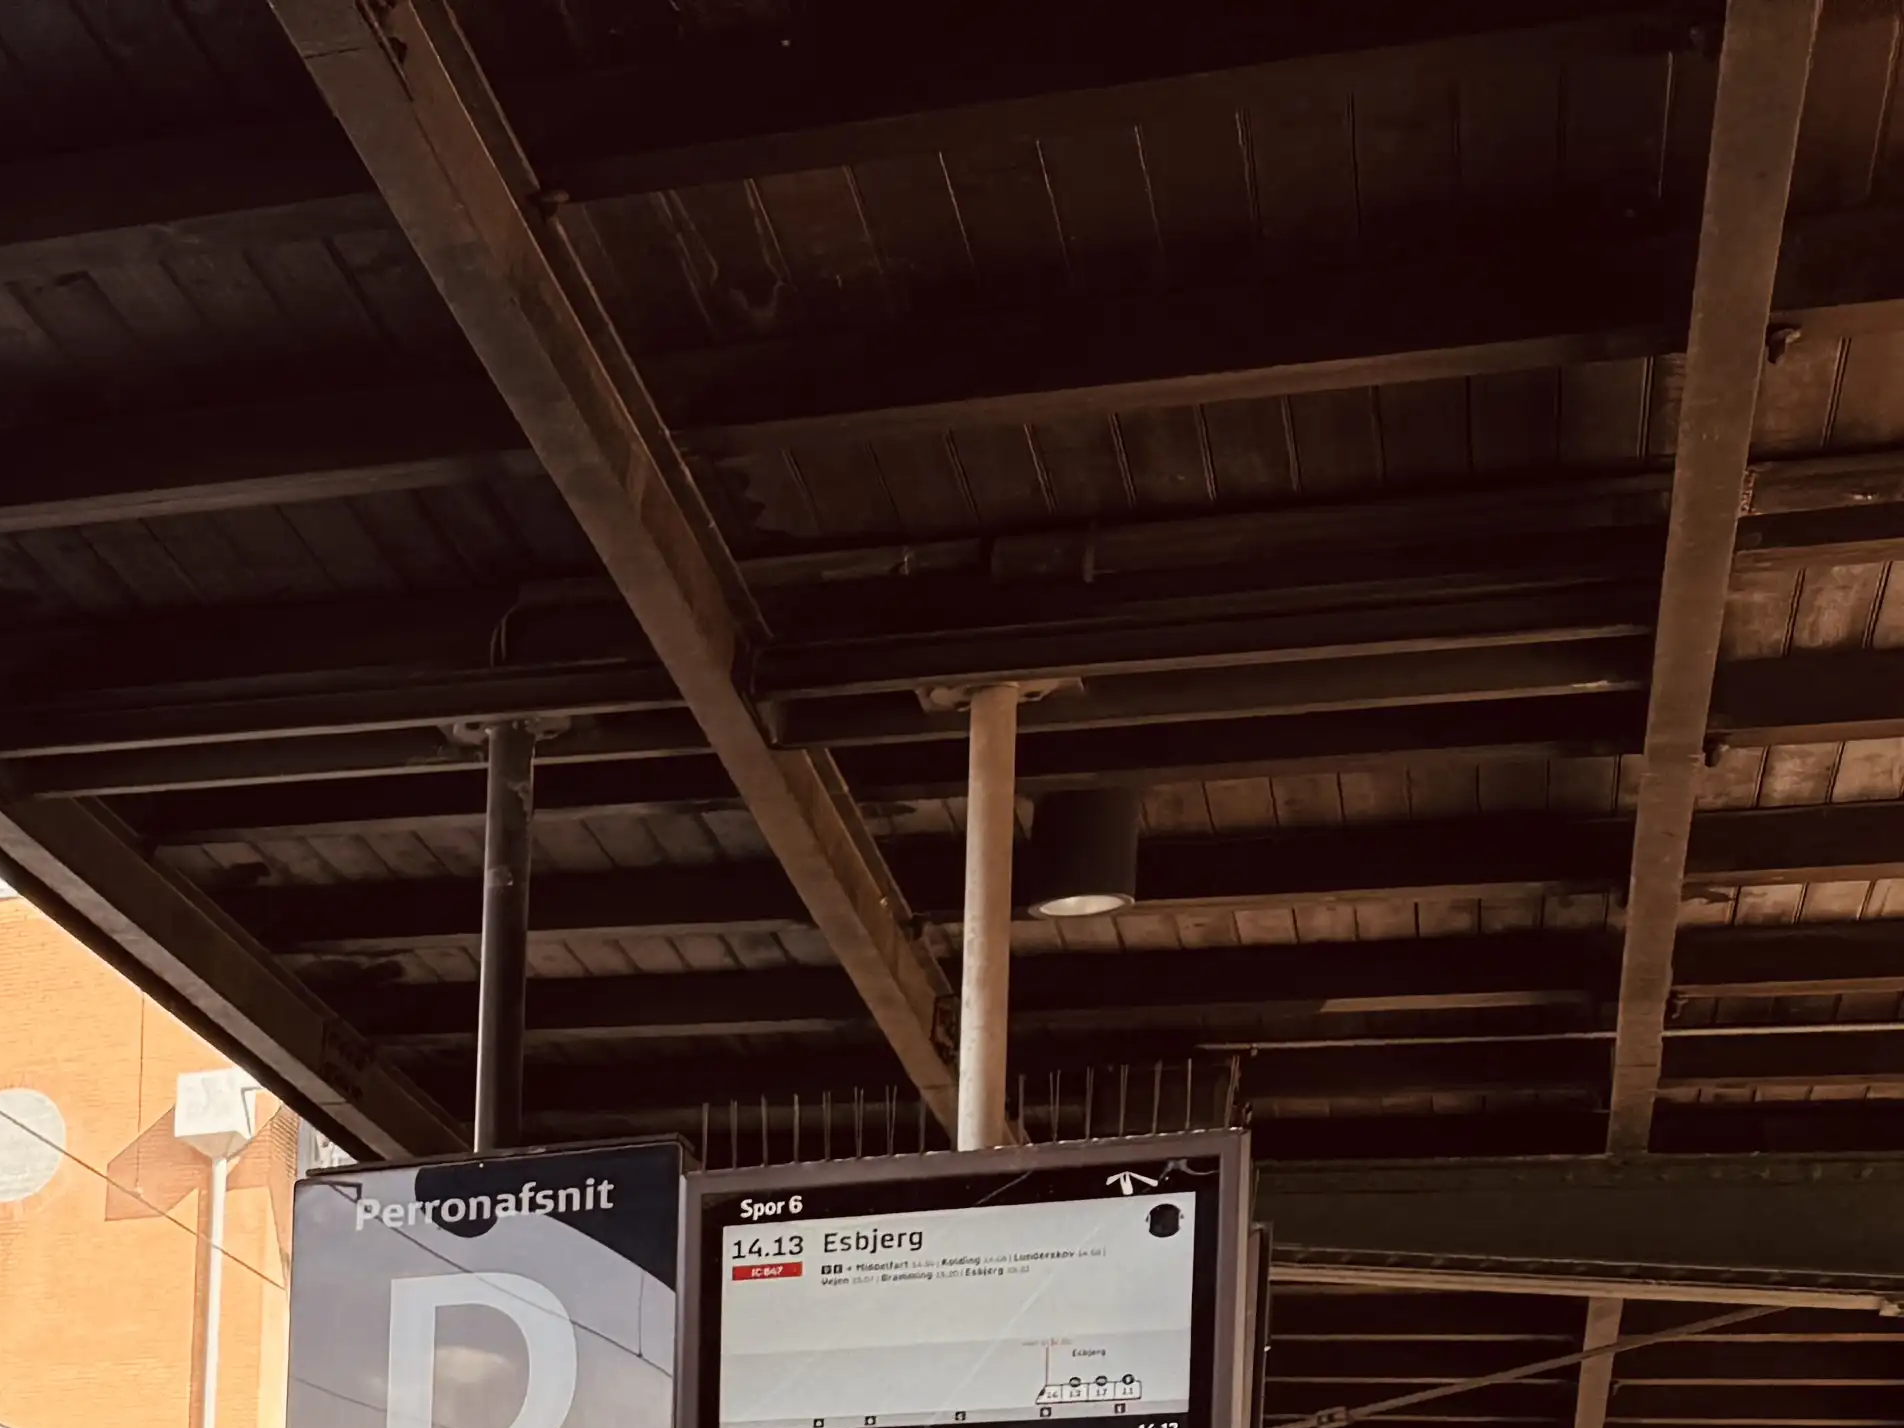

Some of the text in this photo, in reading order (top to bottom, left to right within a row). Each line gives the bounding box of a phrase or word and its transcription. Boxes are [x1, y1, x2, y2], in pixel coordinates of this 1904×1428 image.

[355, 1177, 615, 1231] Perronafsnit
[740, 1195, 804, 1221] Spor 6
[732, 1228, 923, 1260] 14.13 Esbjerg
